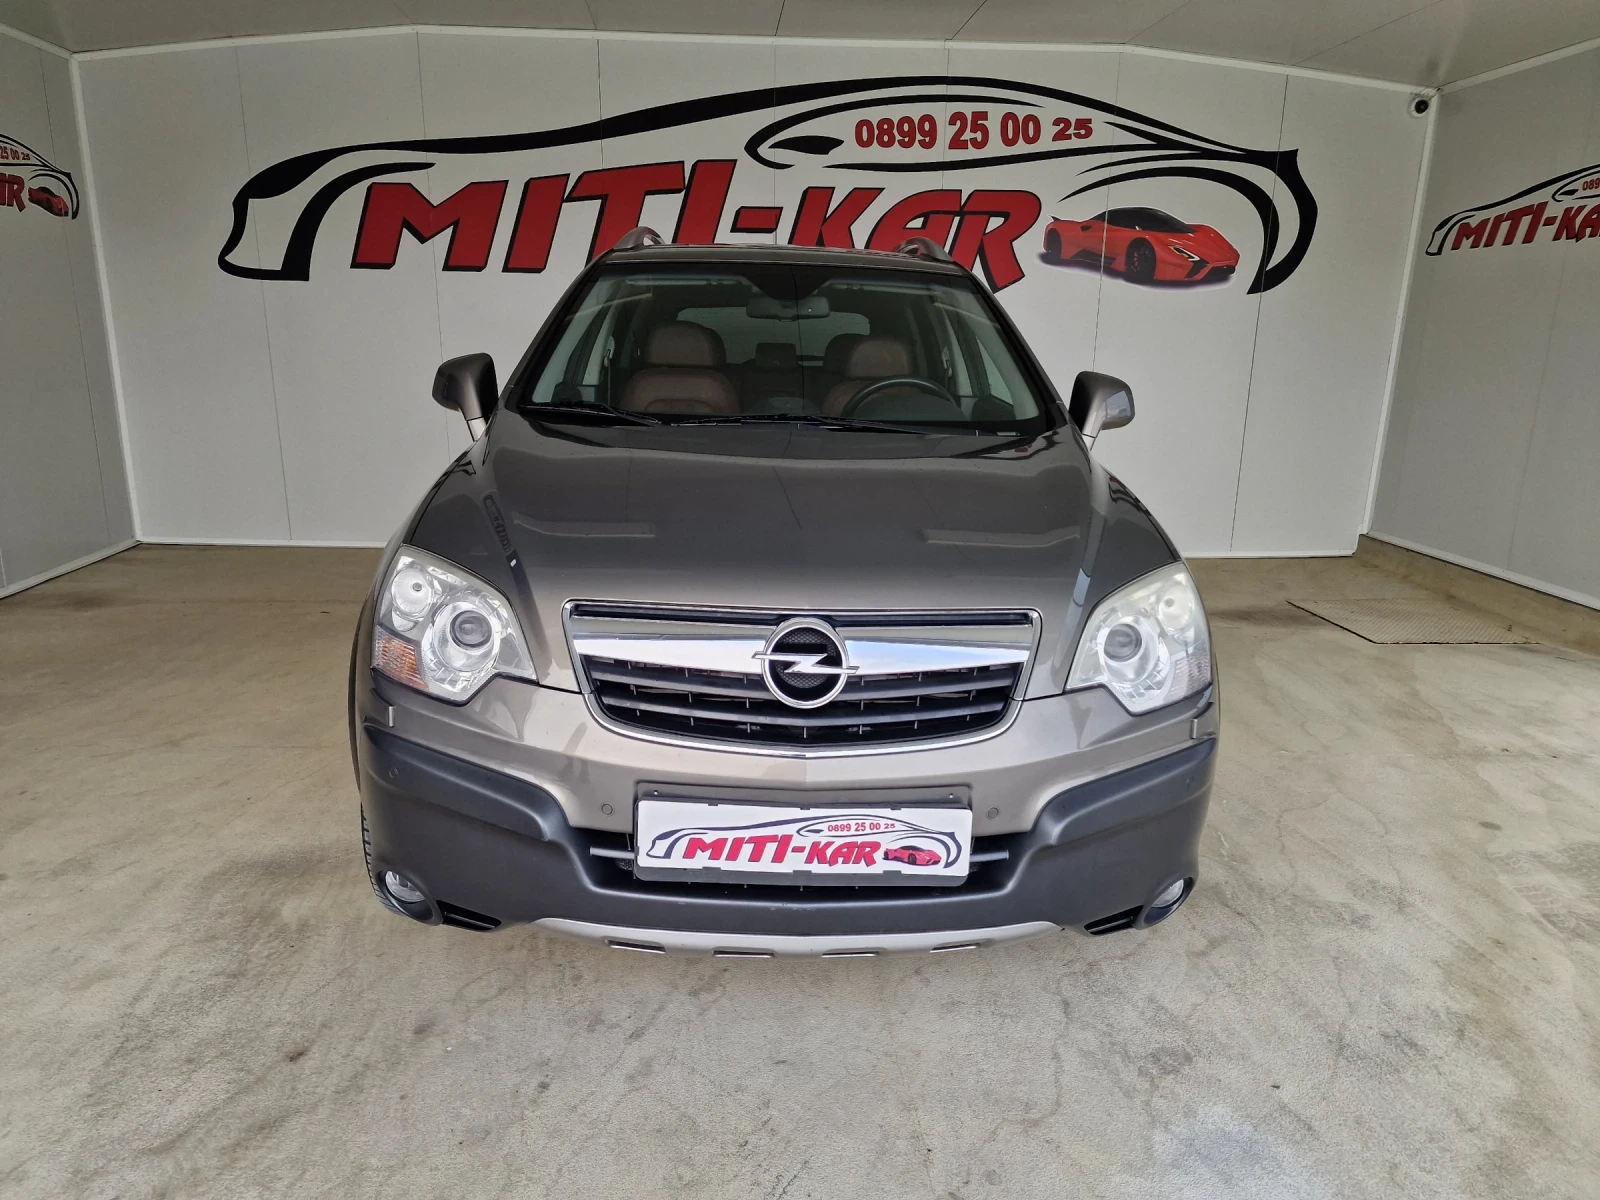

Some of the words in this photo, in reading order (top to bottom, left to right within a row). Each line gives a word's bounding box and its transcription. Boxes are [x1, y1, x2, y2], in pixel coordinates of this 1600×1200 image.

[855, 113, 938, 150] 0899
[948, 111, 990, 150] 25
[1000, 111, 1042, 147] 00
[1052, 117, 1093, 141] 25
[10, 147, 20, 160] 00
[21, 151, 31, 160] 25
[350, 158, 1042, 294] MITI-KAR
[827, 823, 852, 832] 0899
[854, 822, 867, 832] 25
[868, 822, 881, 831] 00
[883, 822, 896, 830] 25
[682, 833, 882, 867] MITI-KAR
